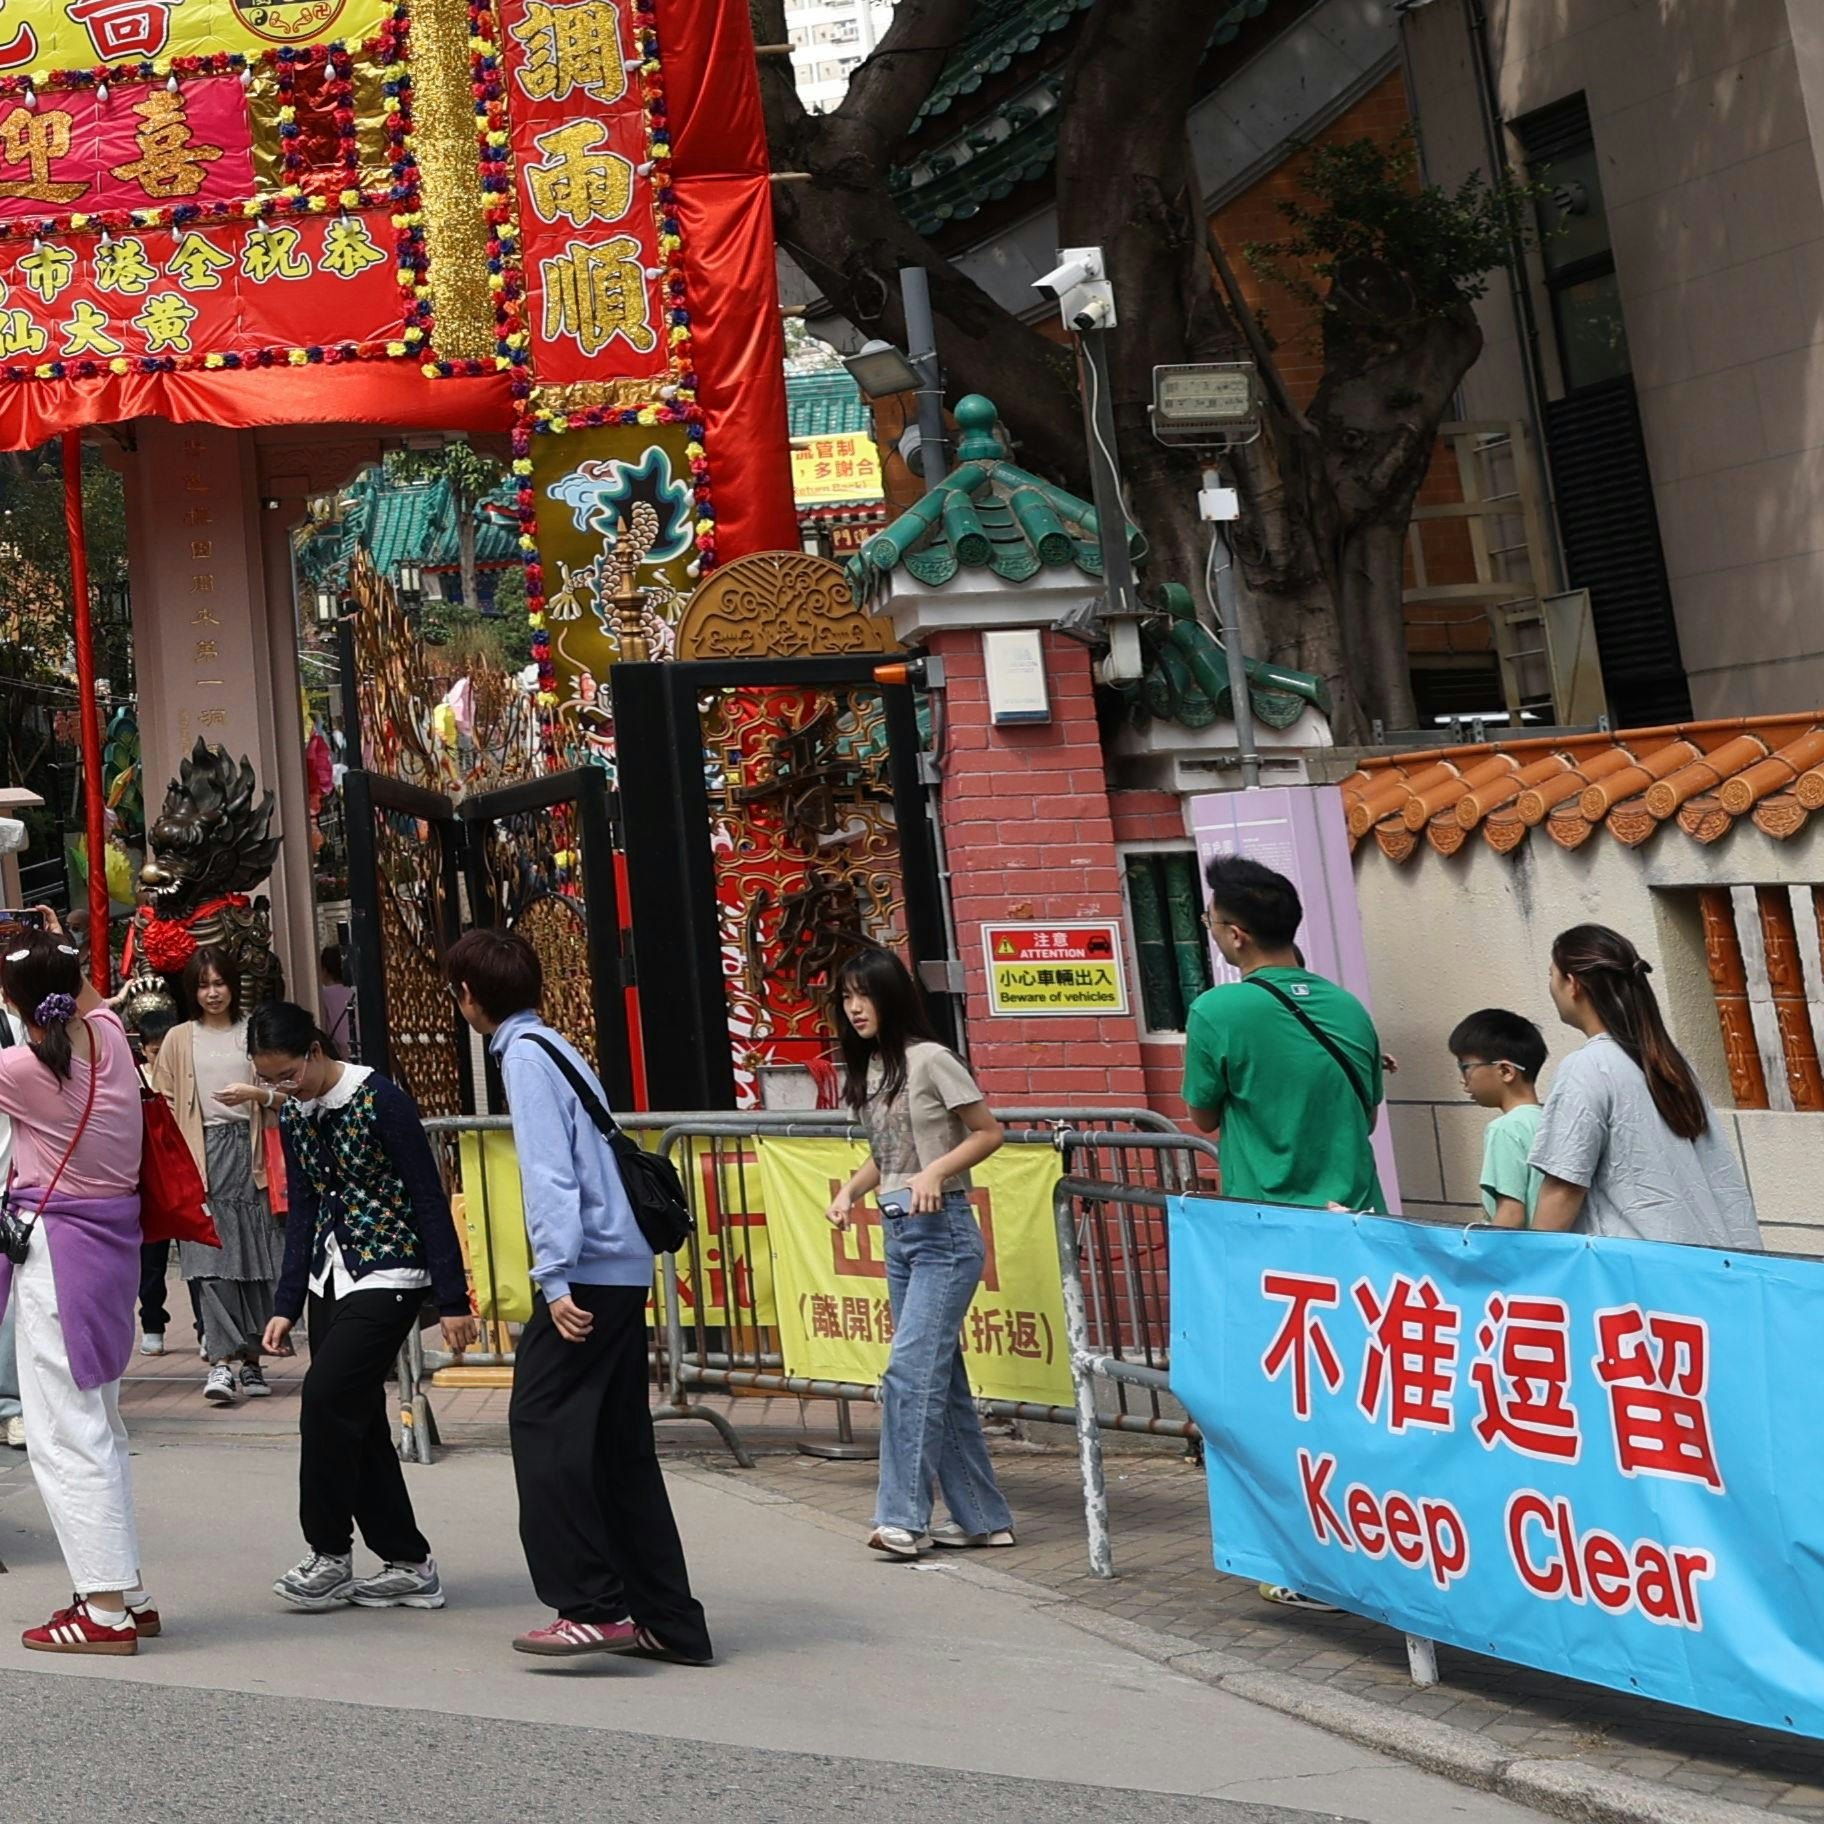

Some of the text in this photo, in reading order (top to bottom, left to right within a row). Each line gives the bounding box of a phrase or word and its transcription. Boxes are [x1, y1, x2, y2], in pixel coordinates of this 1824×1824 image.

[1034, 933, 1068, 947] 注意
[1020, 949, 1085, 958] ATTENTION
[1000, 969, 1112, 986] 小心車輛出入
[1001, 992, 1115, 1002] Beware of vehicles
[1262, 1269, 1726, 1495] 不准逗留
[1297, 1446, 1716, 1632] Keep Clear
